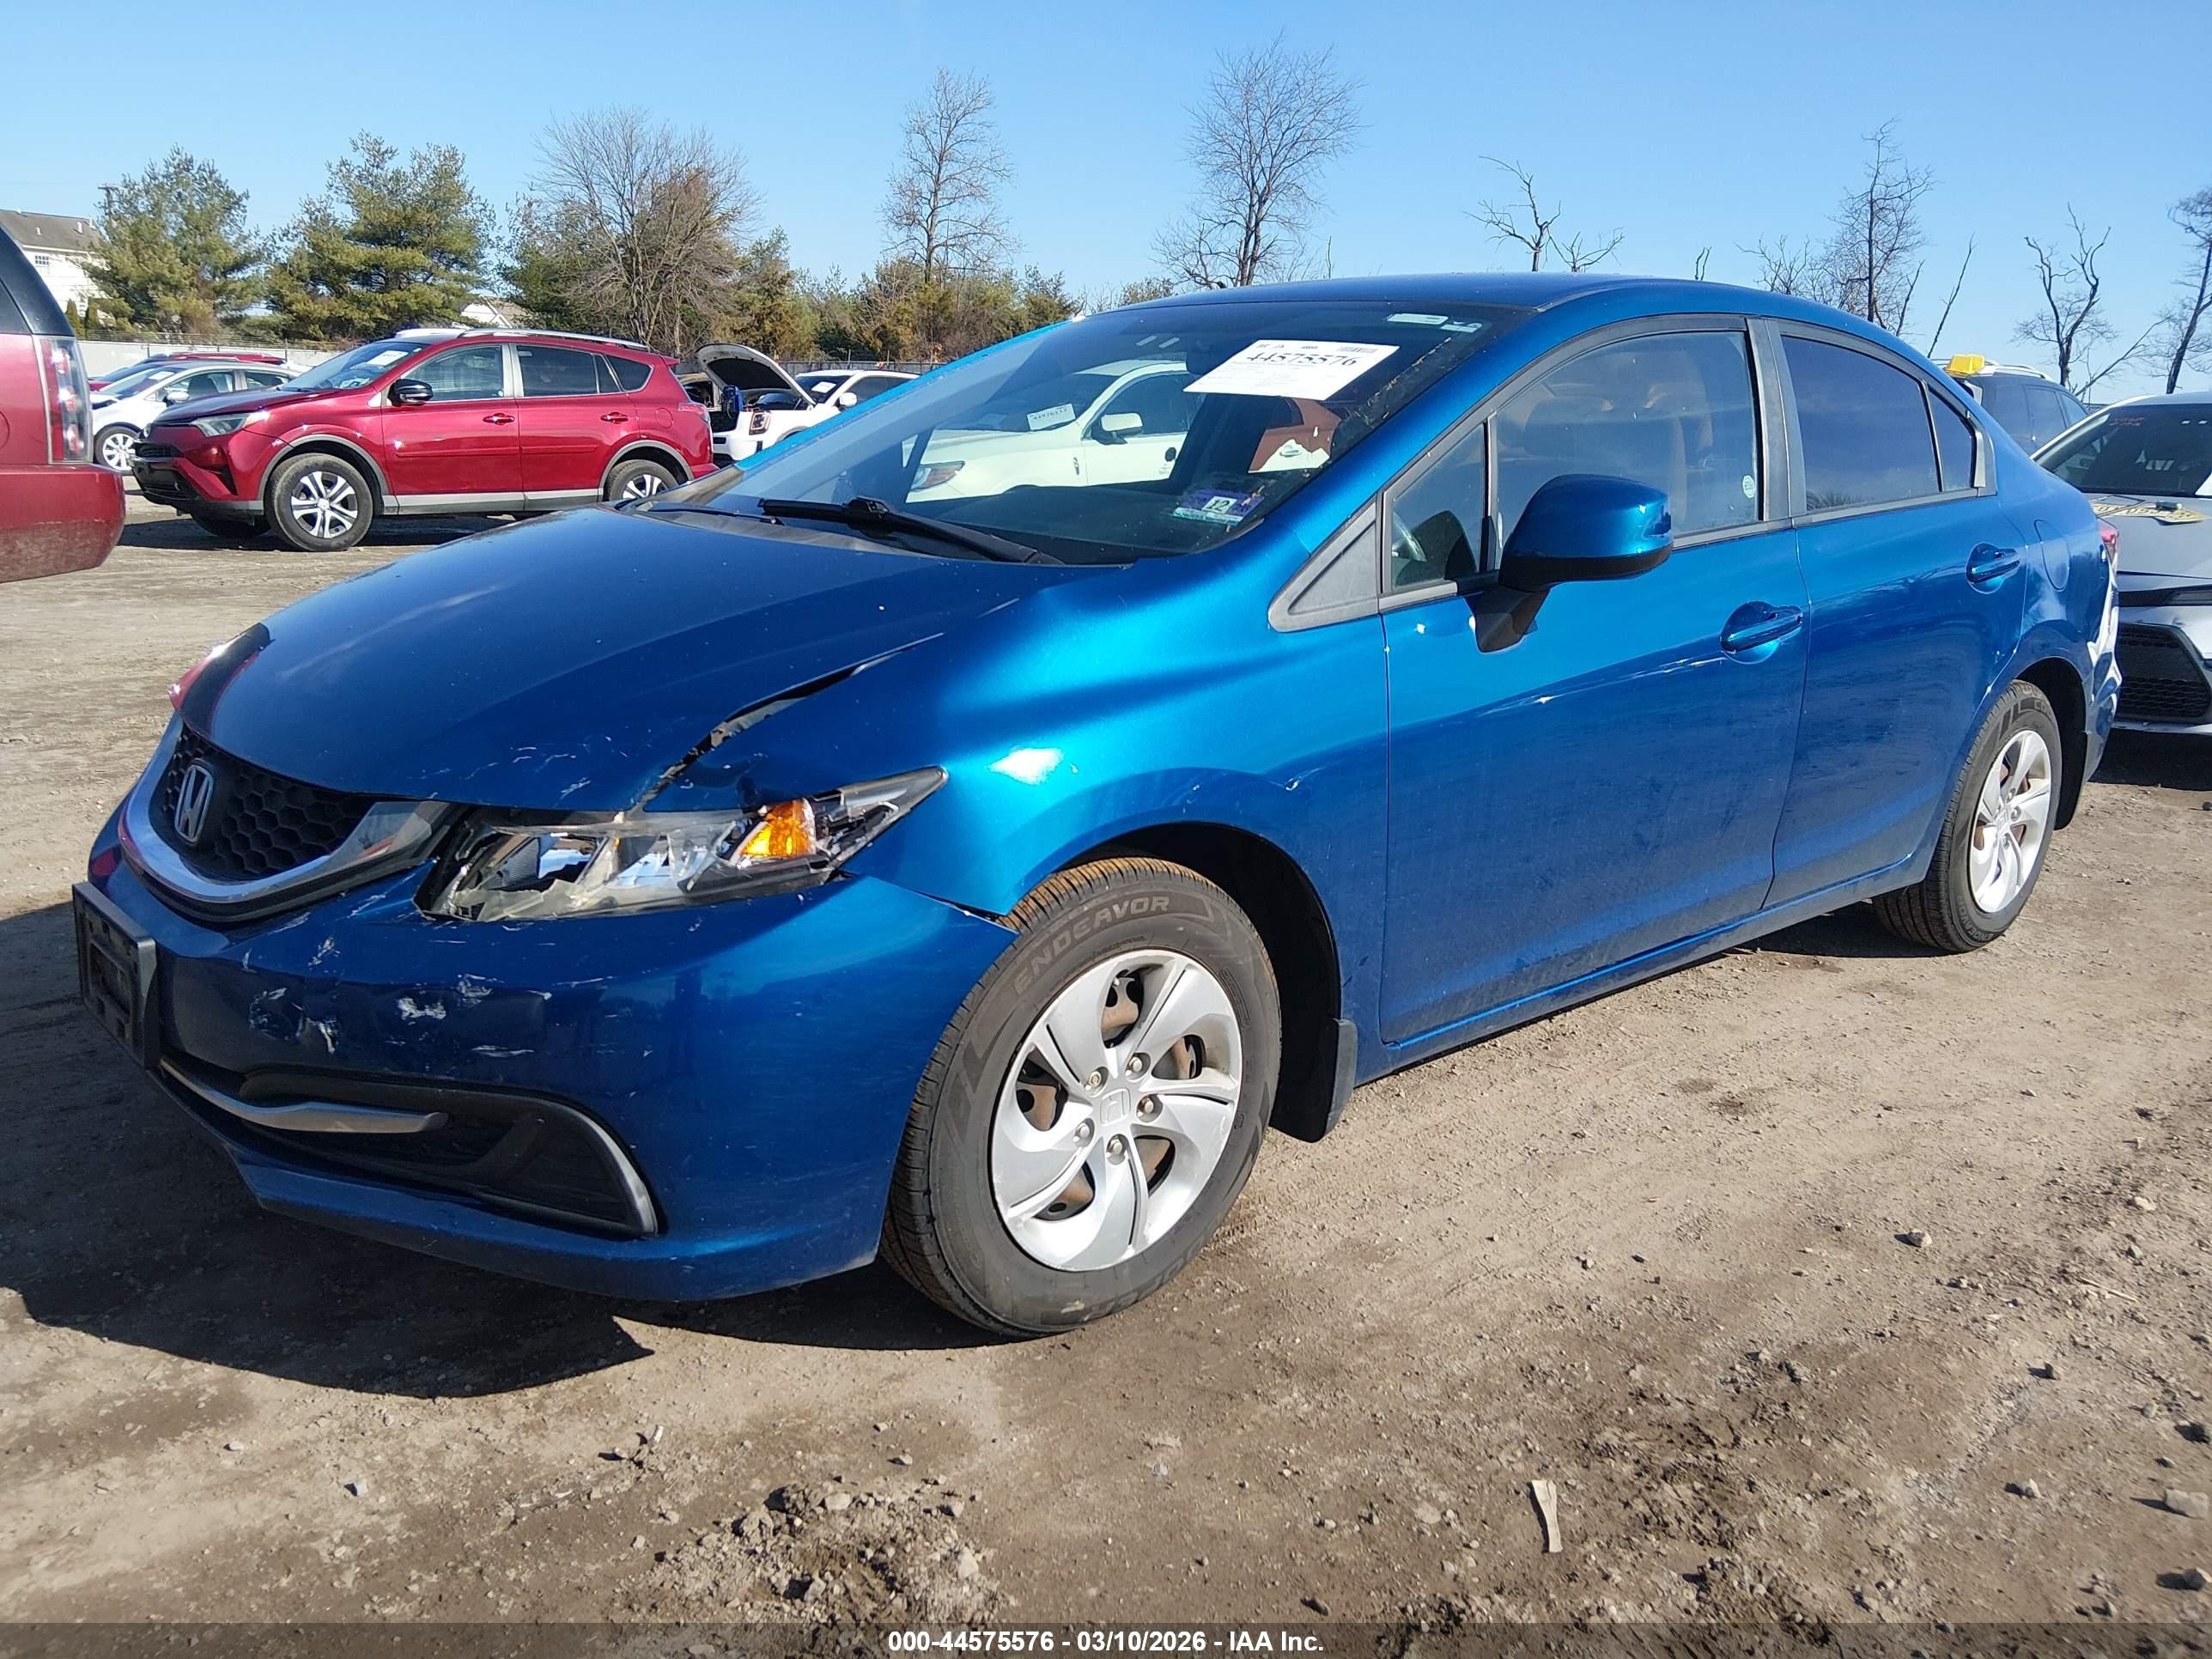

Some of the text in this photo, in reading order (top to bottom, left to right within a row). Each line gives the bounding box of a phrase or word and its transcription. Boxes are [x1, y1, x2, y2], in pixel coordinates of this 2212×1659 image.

[1247, 352, 1361, 366] 44575576
[1206, 500, 1231, 512] 12
[1013, 896, 1170, 995] ENDEAVOR
